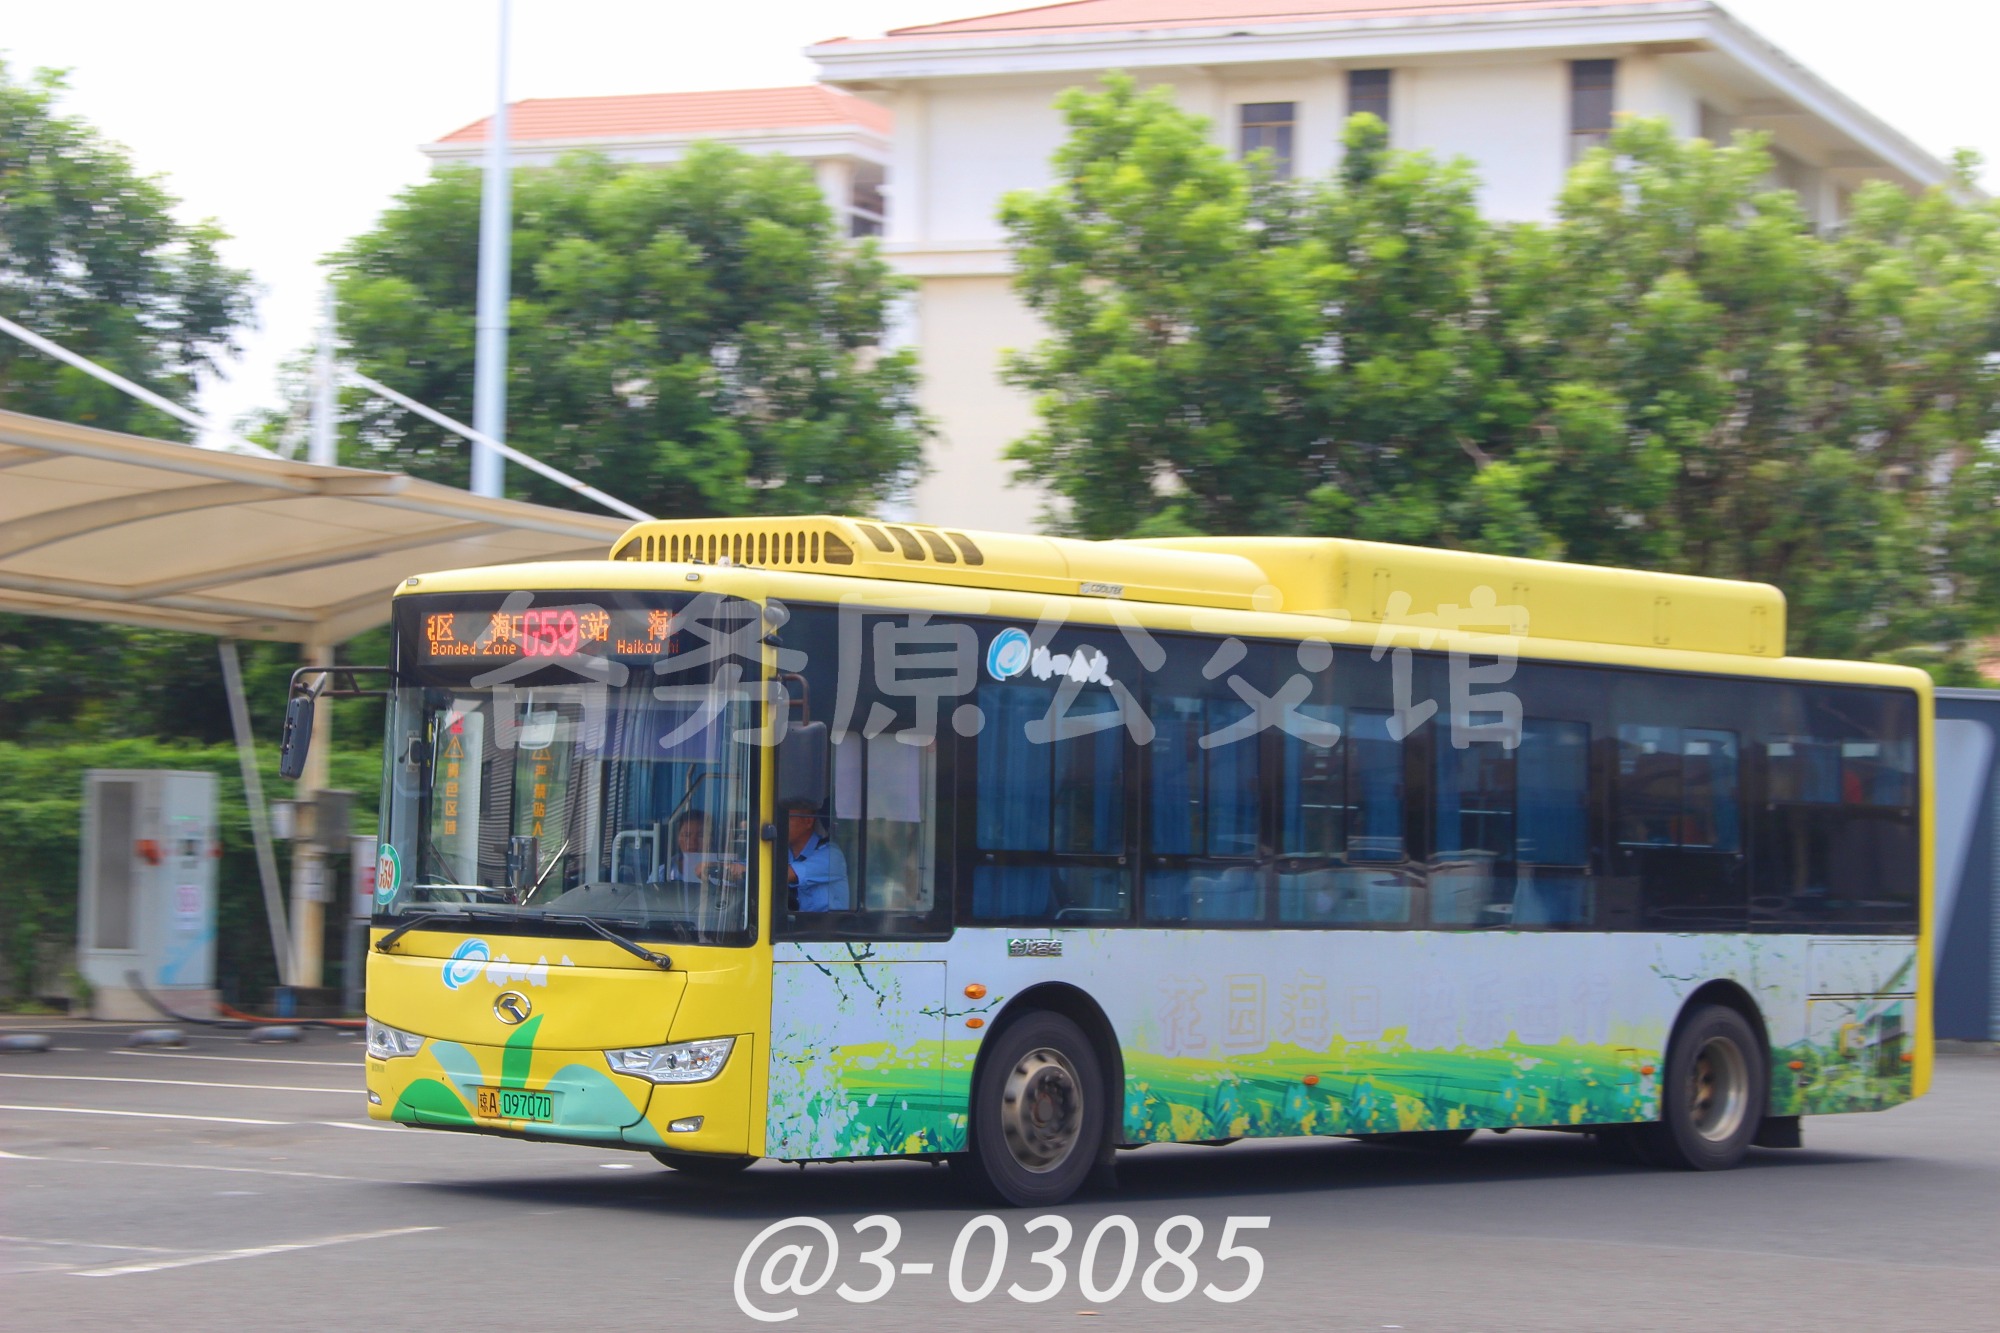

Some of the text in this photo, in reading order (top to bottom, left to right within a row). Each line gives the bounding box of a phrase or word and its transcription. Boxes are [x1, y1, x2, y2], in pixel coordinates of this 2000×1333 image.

[522, 610, 578, 657] G59
[431, 640, 517, 655] Bonded Zone
[617, 639, 661, 654] Haikou
[1009, 938, 1063, 957] 金龙客车
[503, 1093, 551, 1118] 09707D
